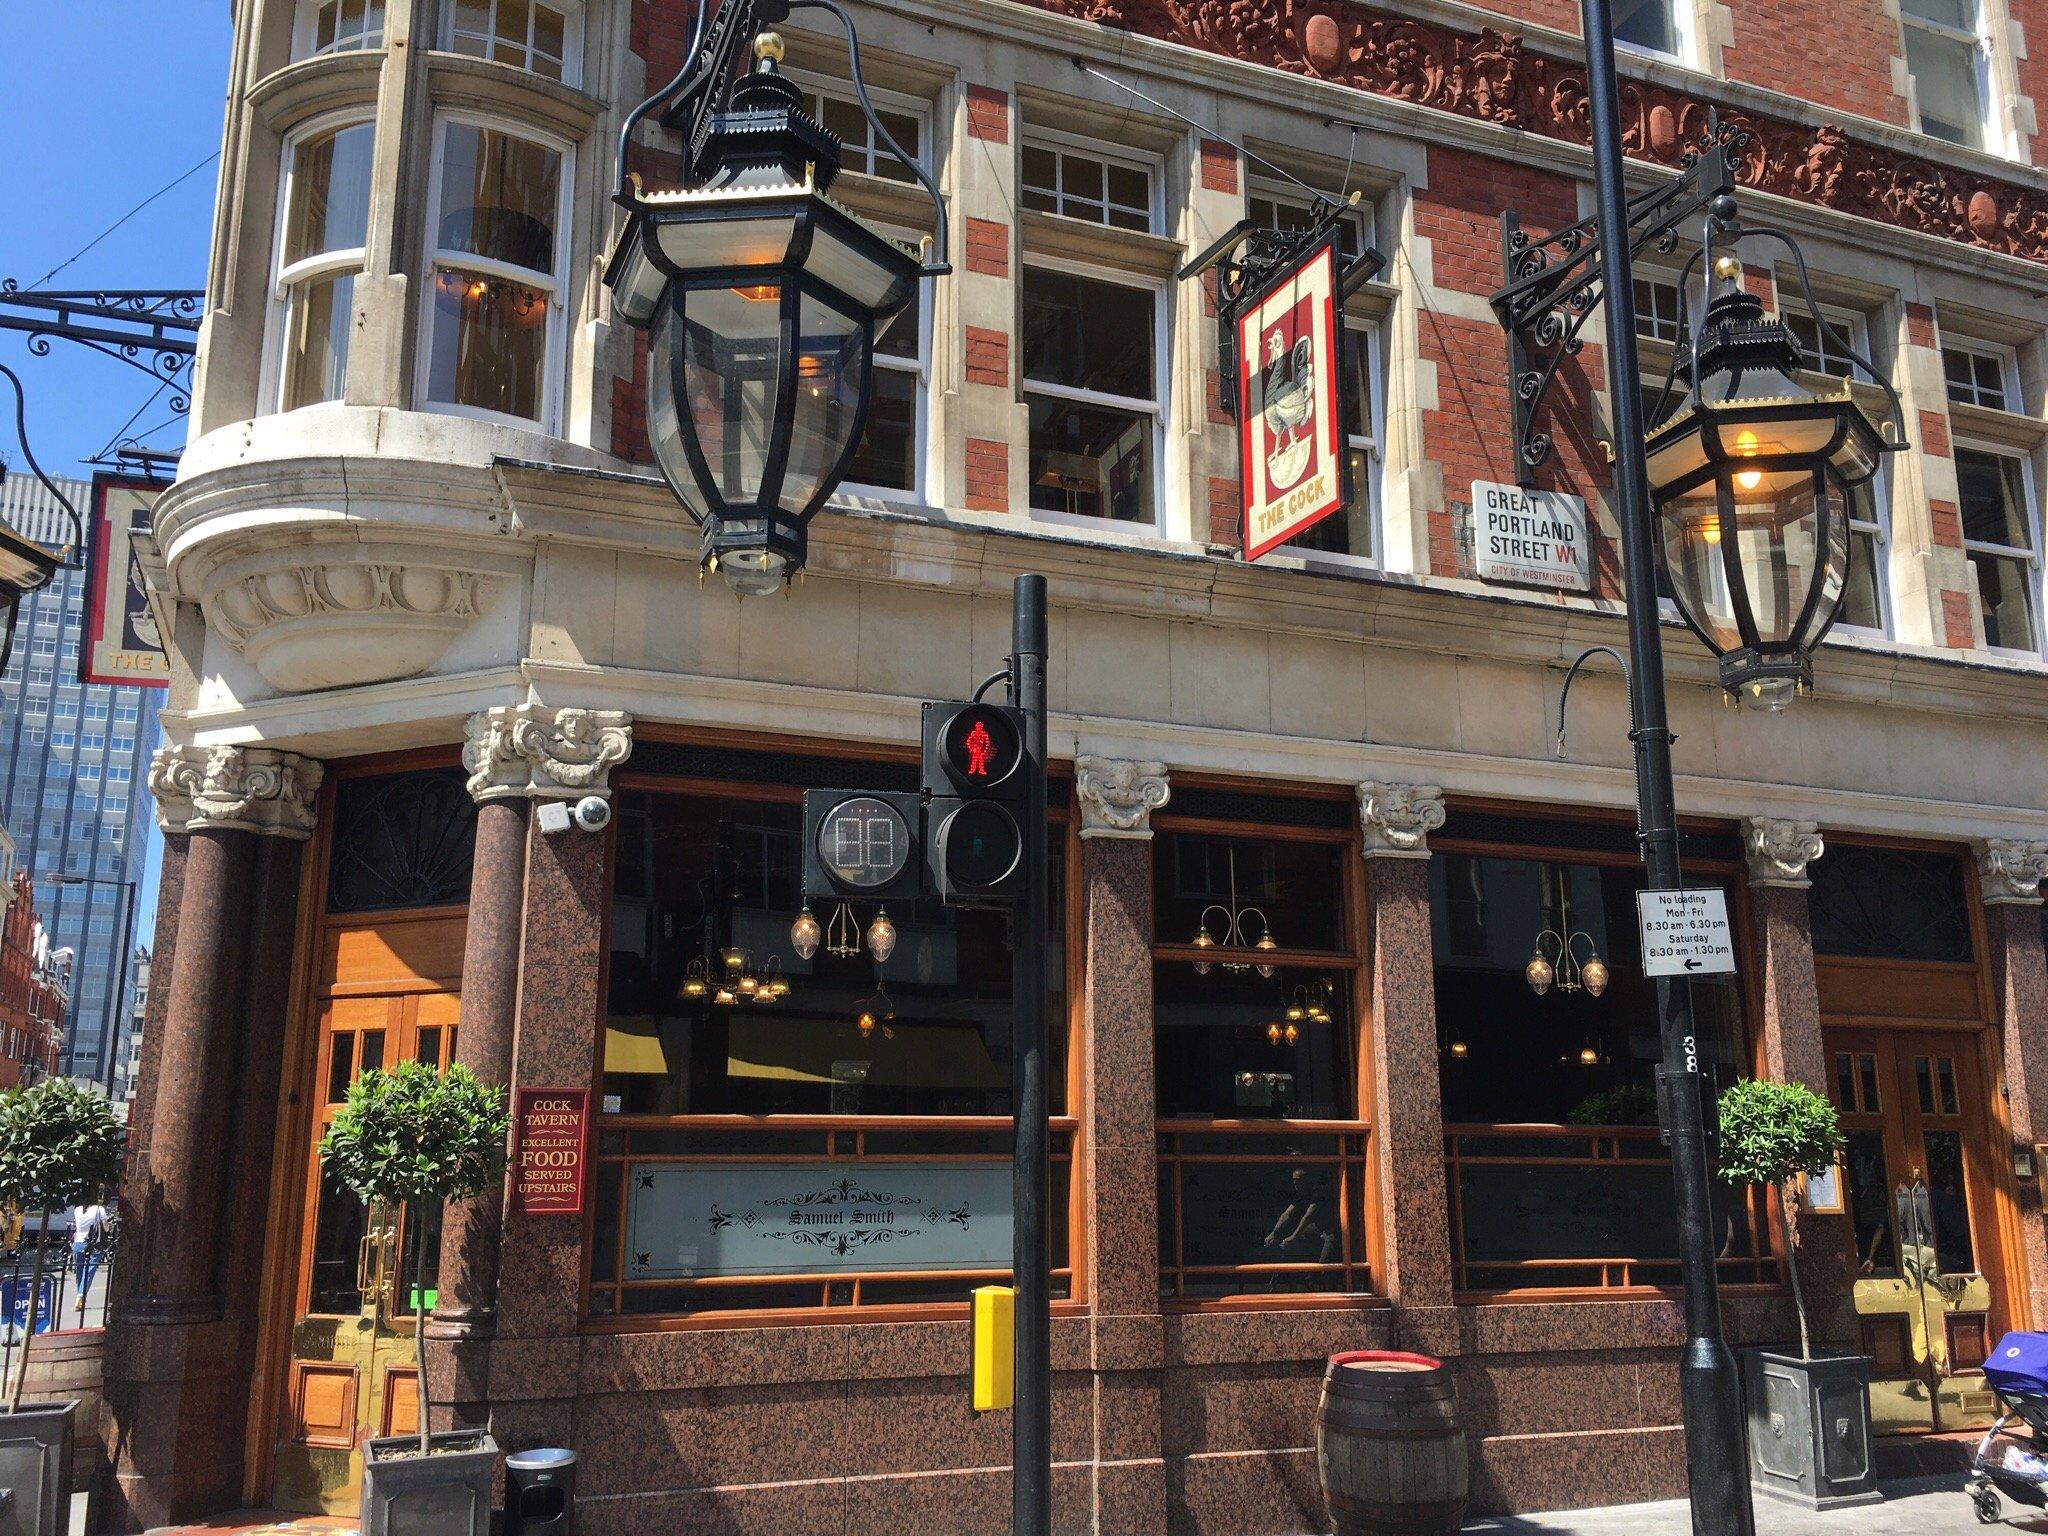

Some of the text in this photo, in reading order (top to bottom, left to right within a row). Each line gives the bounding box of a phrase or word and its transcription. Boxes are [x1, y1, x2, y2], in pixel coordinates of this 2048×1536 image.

[1258, 475, 1326, 533] THE COCK
[1486, 490, 1539, 514] GREAT
[1488, 513, 1574, 542] PORTLAND
[1490, 535, 1578, 565] STREET W1
[1491, 565, 1575, 585] CITY OF WESTMINSTER
[108, 652, 153, 671] THE
[1659, 894, 1707, 905] No loading
[1666, 908, 1685, 918] Mon
[1692, 907, 1704, 917] Fri
[1646, 921, 1669, 931] 8.30
[1670, 922, 1684, 930] am
[1690, 919, 1711, 929] 6.30
[1712, 920, 1726, 930] pm
[1668, 934, 1709, 944] Saturday
[1649, 947, 1674, 957] 8.30
[1675, 948, 1689, 956] am
[1694, 945, 1714, 955] 1.30
[1715, 946, 1729, 956] pm
[533, 1100, 571, 1111] COCK
[525, 1114, 580, 1126] TAVERN
[522, 1139, 579, 1147] EXCELLENT
[520, 1150, 578, 1167] FOOD
[524, 1170, 573, 1180] SERVED
[518, 1182, 577, 1194] UPSTAIRS
[788, 1208, 894, 1226] Samuel Smith
[14, 1299, 46, 1310] OPN
